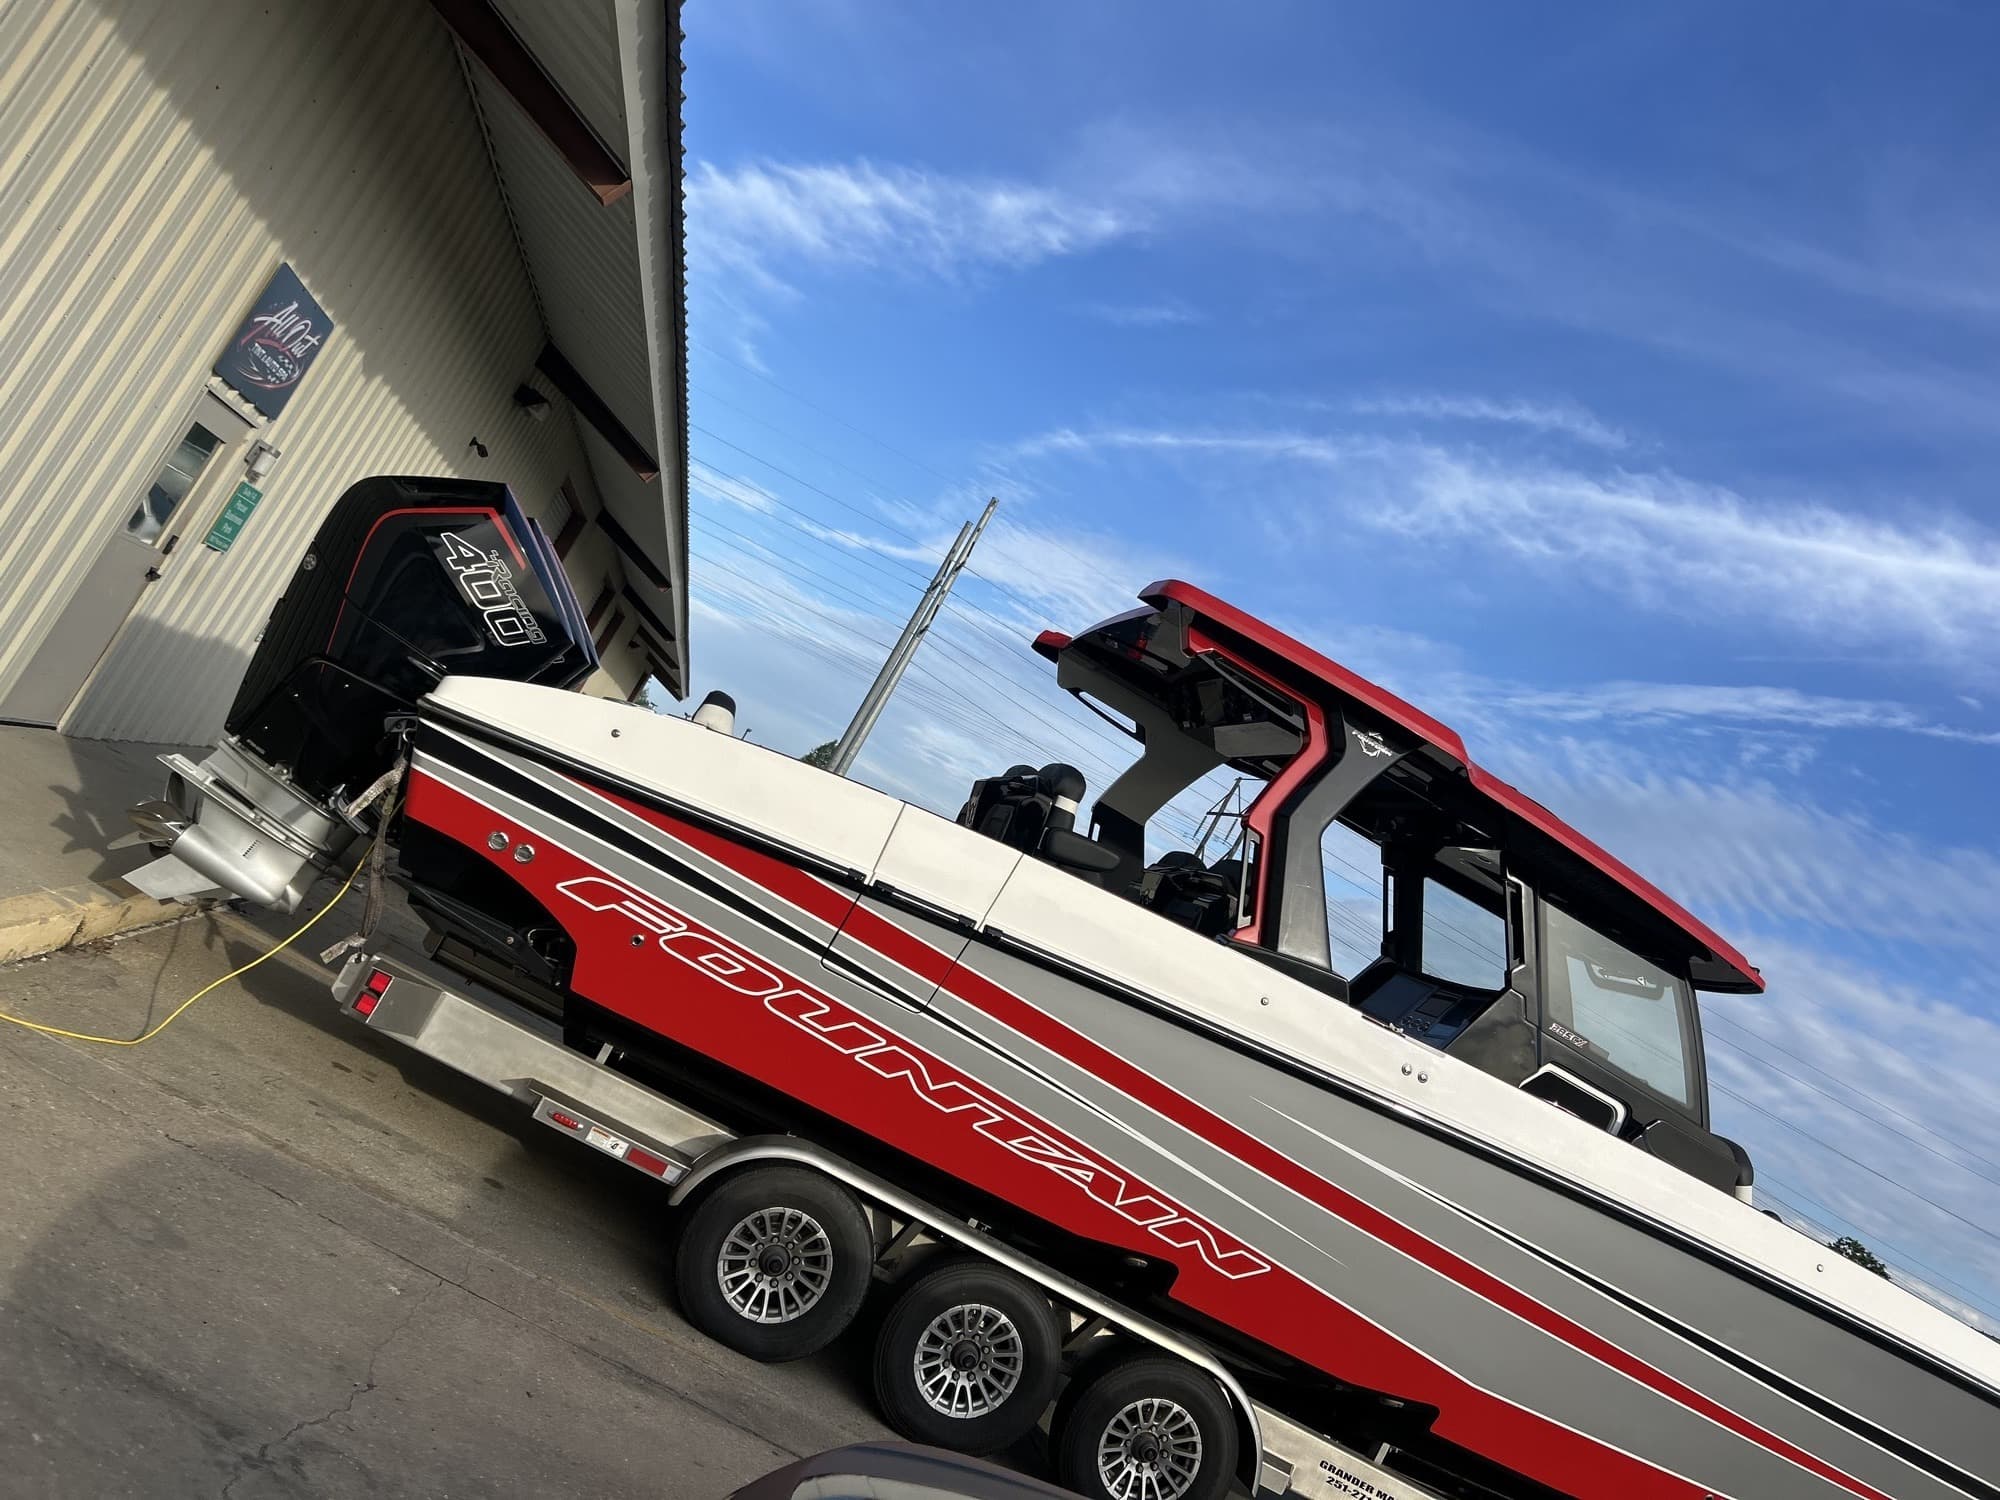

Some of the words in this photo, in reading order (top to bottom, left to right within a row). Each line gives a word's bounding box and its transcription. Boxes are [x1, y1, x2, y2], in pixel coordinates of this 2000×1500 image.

[254, 301, 299, 337] All
[282, 319, 321, 358] Out
[263, 355, 281, 374] AUTO
[275, 366, 290, 381] SPA
[440, 532, 532, 646] 400
[556, 876, 1271, 1280] FOUNTAIN
[1319, 1460, 1375, 1494] GRANDER
